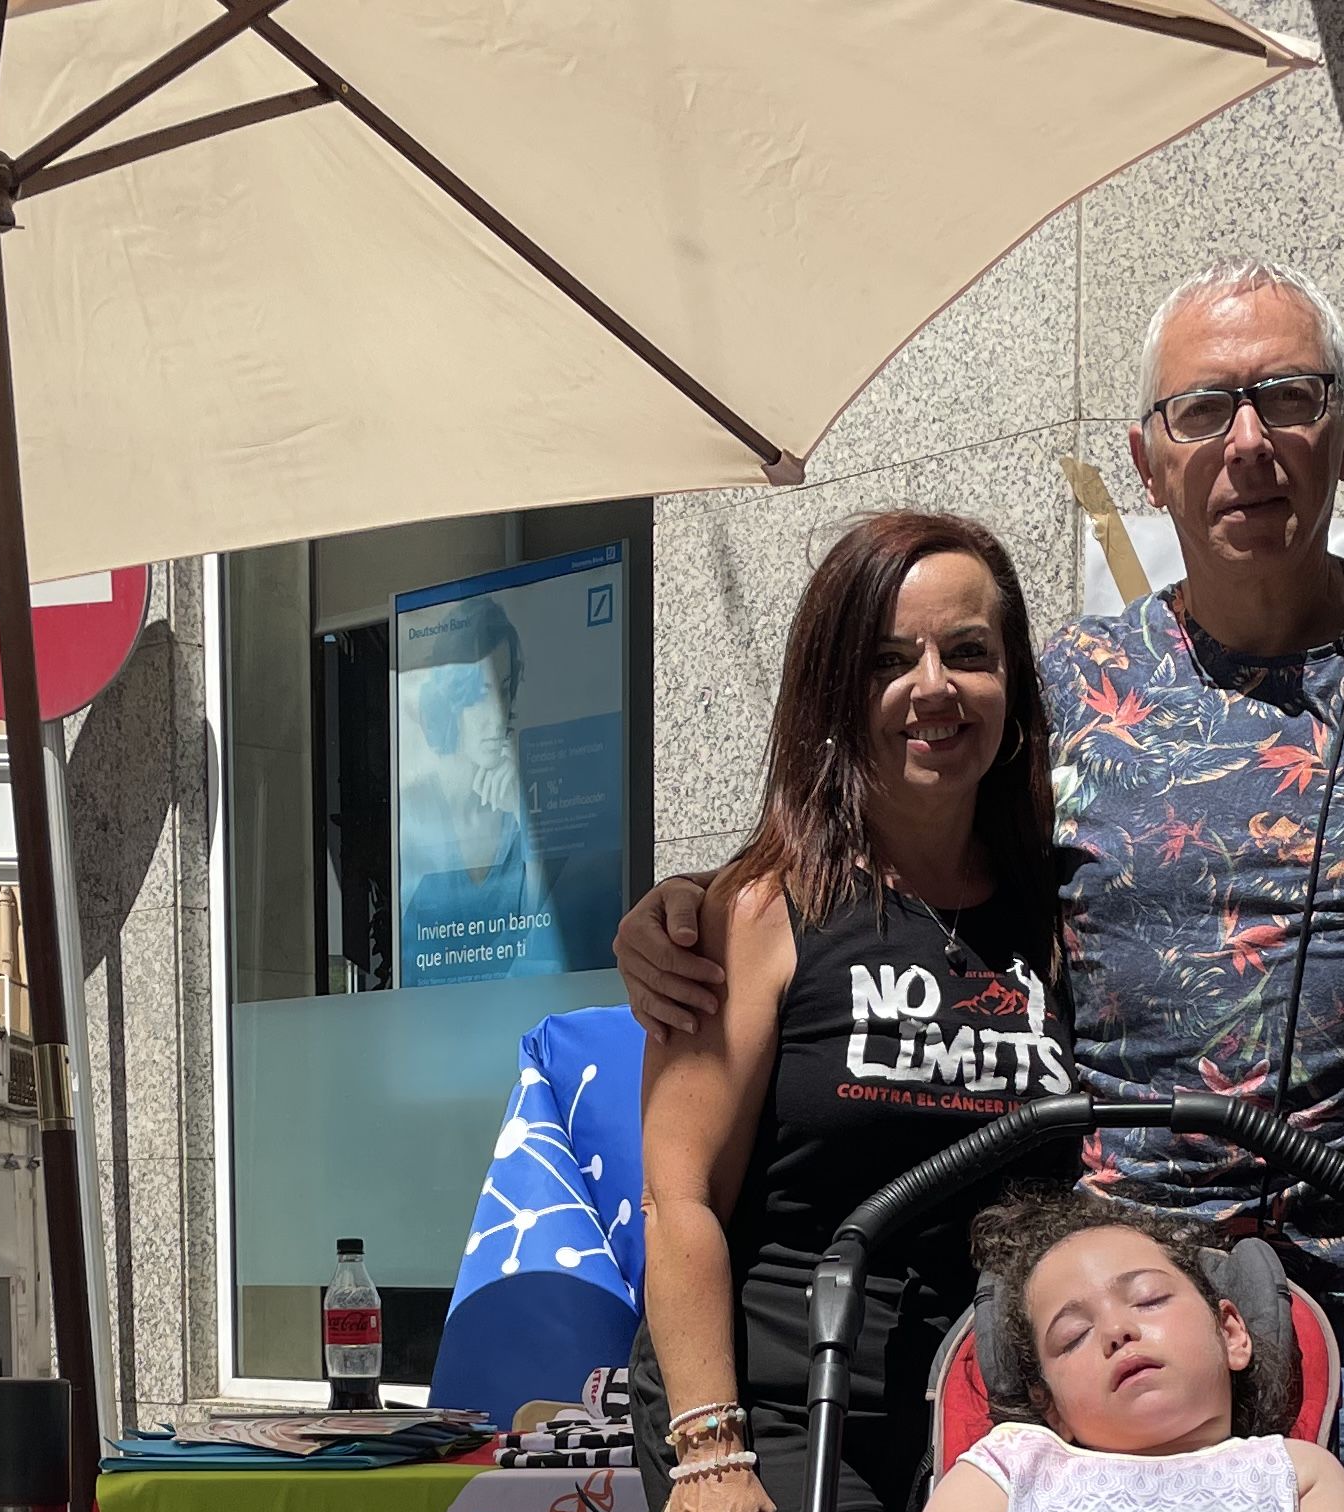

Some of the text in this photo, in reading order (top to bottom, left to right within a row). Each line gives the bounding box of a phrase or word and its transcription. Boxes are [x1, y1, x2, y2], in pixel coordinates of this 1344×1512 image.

[408, 622, 449, 641] Deutsche
[417, 912, 552, 941] Invierte en un banco
[416, 939, 527, 972] que invierte en ti
[849, 964, 942, 1021] NO
[846, 1018, 1073, 1096] LIMITS
[836, 1082, 913, 1106] CONTRA
[916, 1092, 936, 1107] EL
[940, 1090, 1005, 1114] CÁNCER
